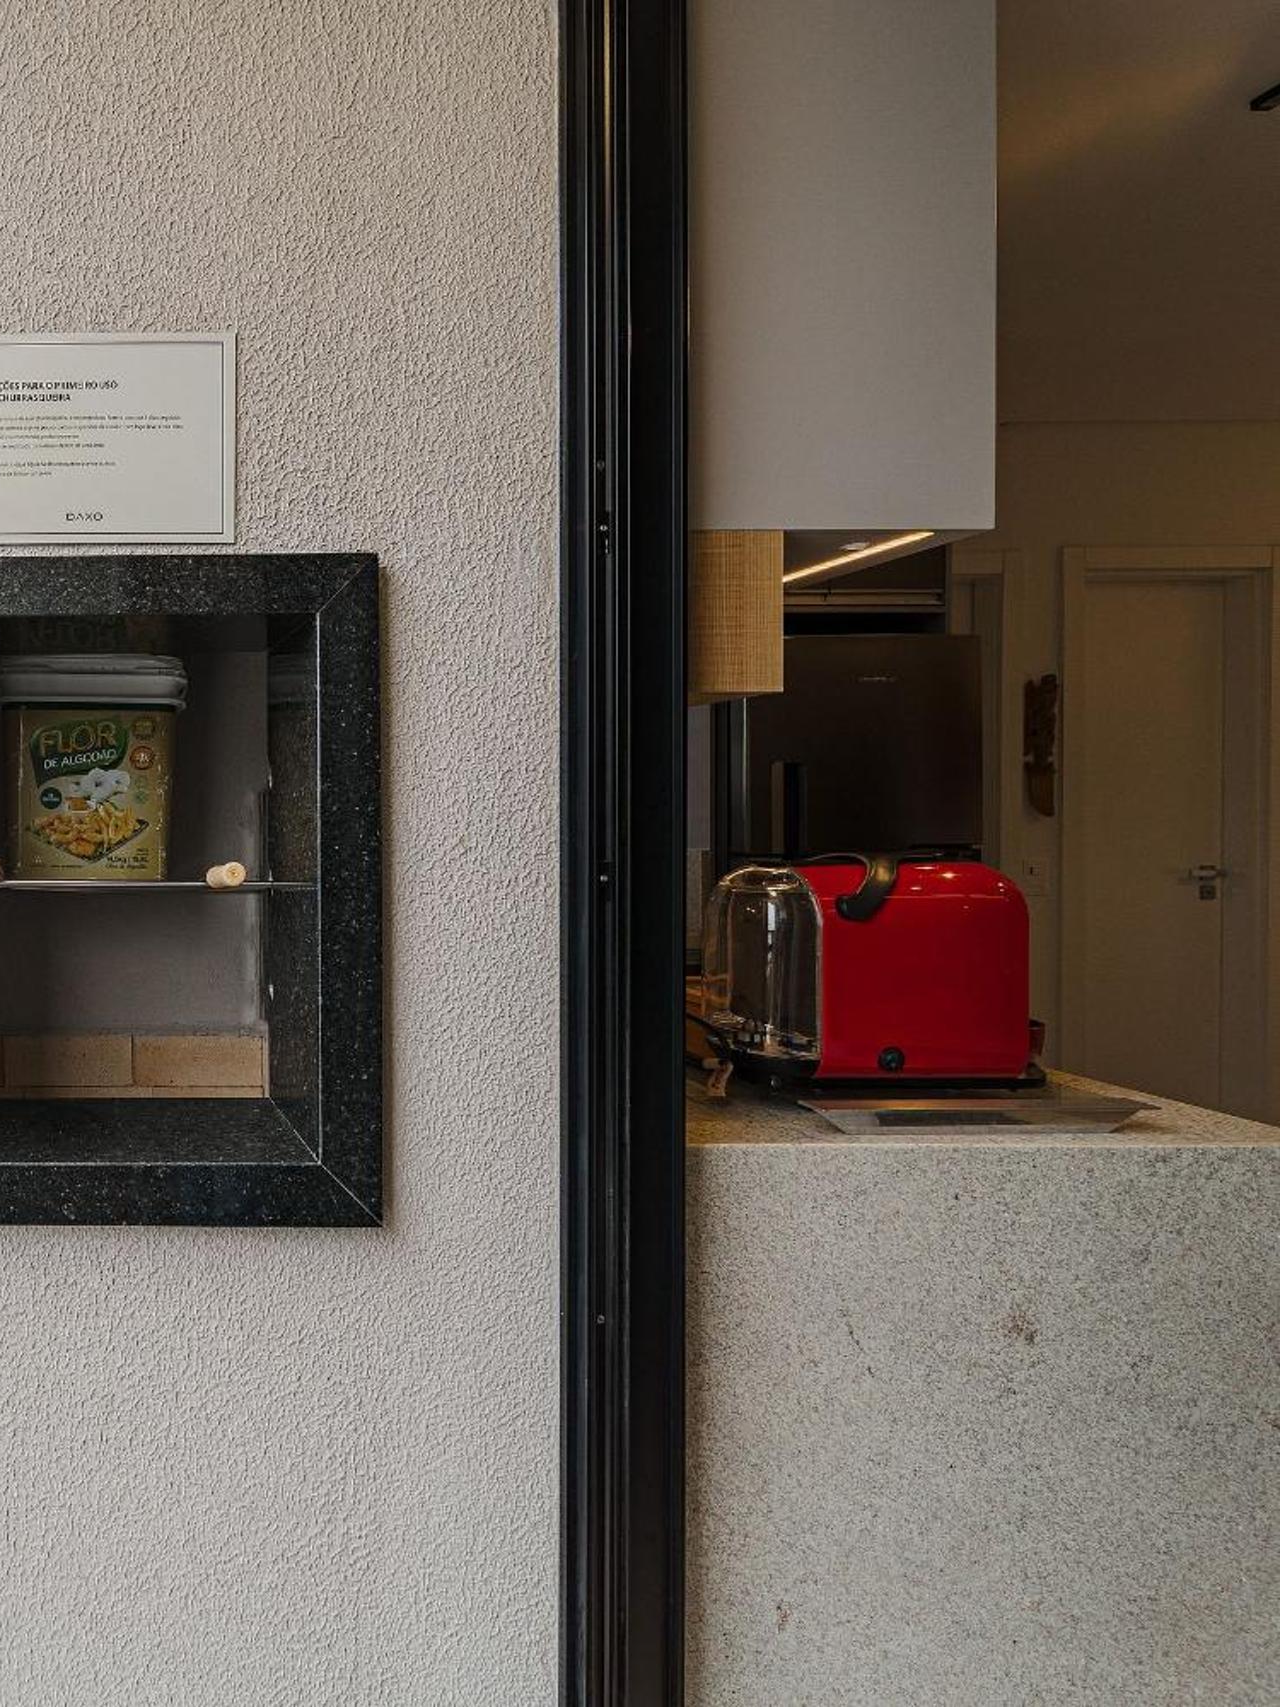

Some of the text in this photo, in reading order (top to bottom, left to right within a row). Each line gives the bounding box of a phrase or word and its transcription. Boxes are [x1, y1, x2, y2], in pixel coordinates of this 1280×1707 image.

[21, 381, 45, 390] PARA
[38, 720, 117, 759] FLOR
[43, 757, 59, 770] DE
